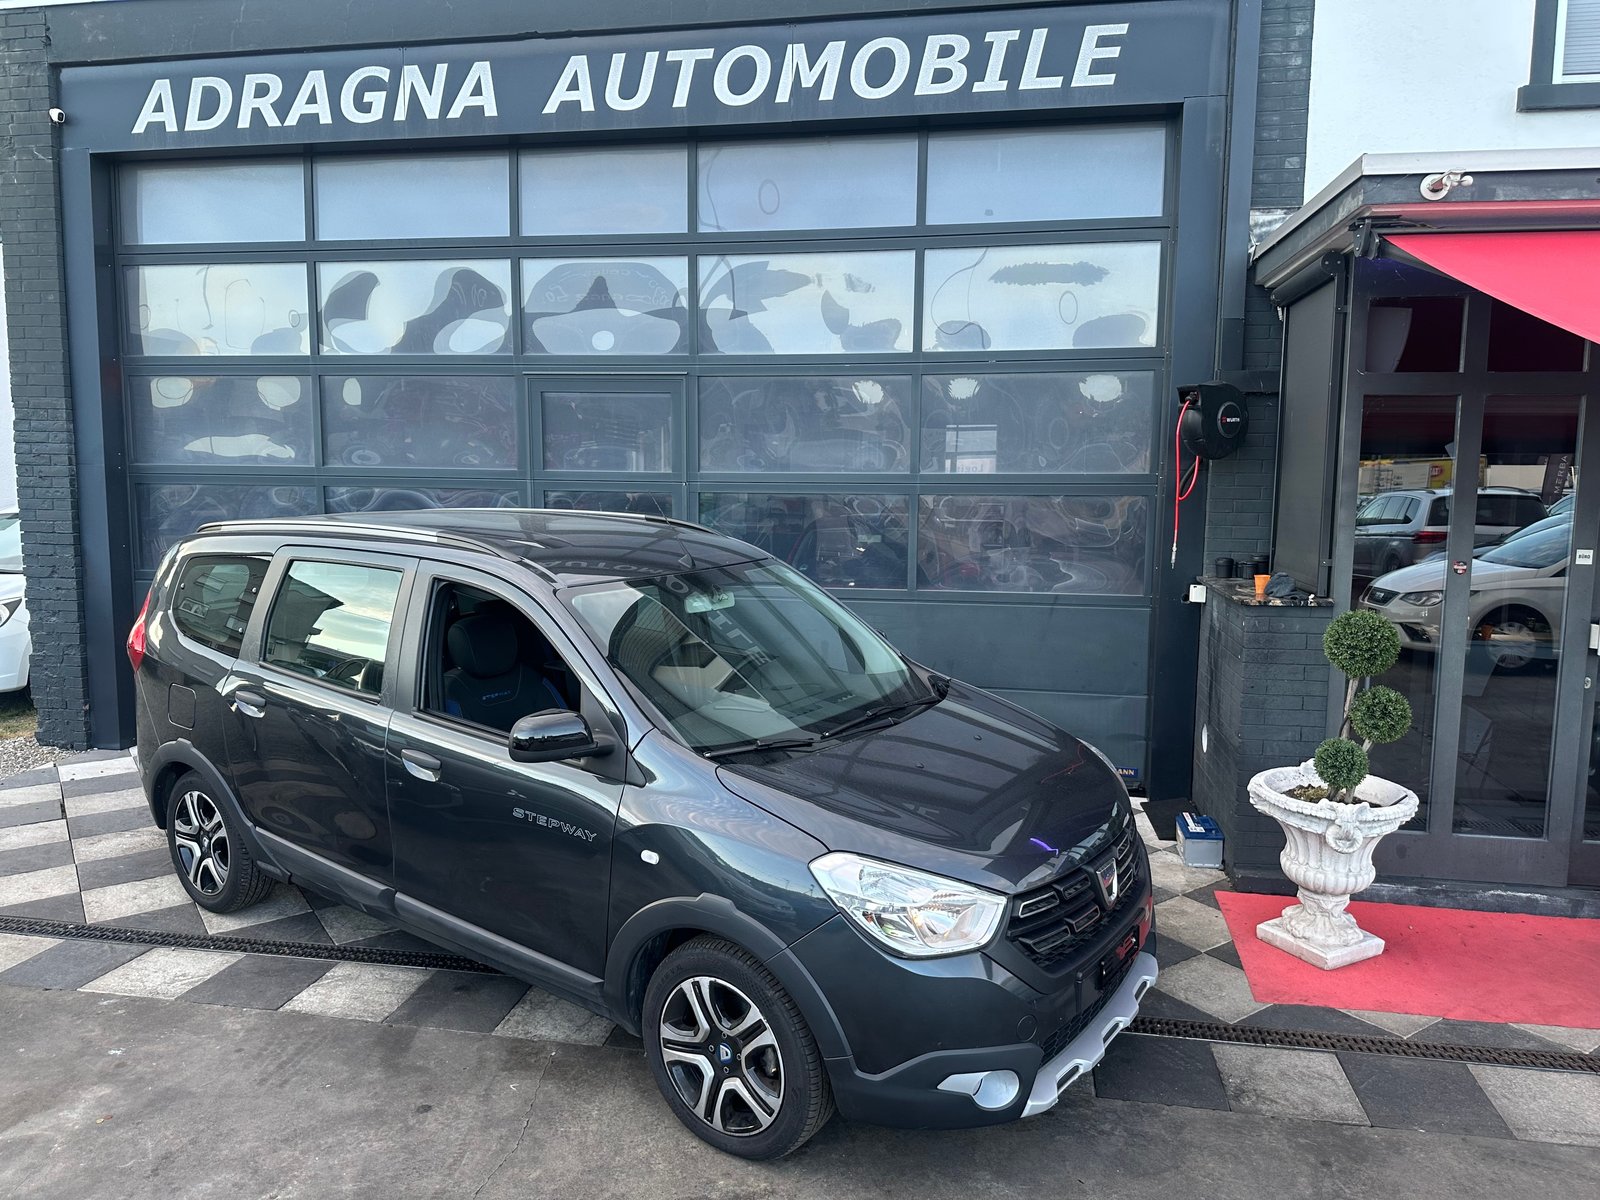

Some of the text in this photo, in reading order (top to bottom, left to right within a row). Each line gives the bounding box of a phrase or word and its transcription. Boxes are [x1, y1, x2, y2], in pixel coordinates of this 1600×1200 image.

[131, 23, 1129, 135] ADRAGNA AUTOMOBILE
[512, 807, 597, 842] STEPWAY
